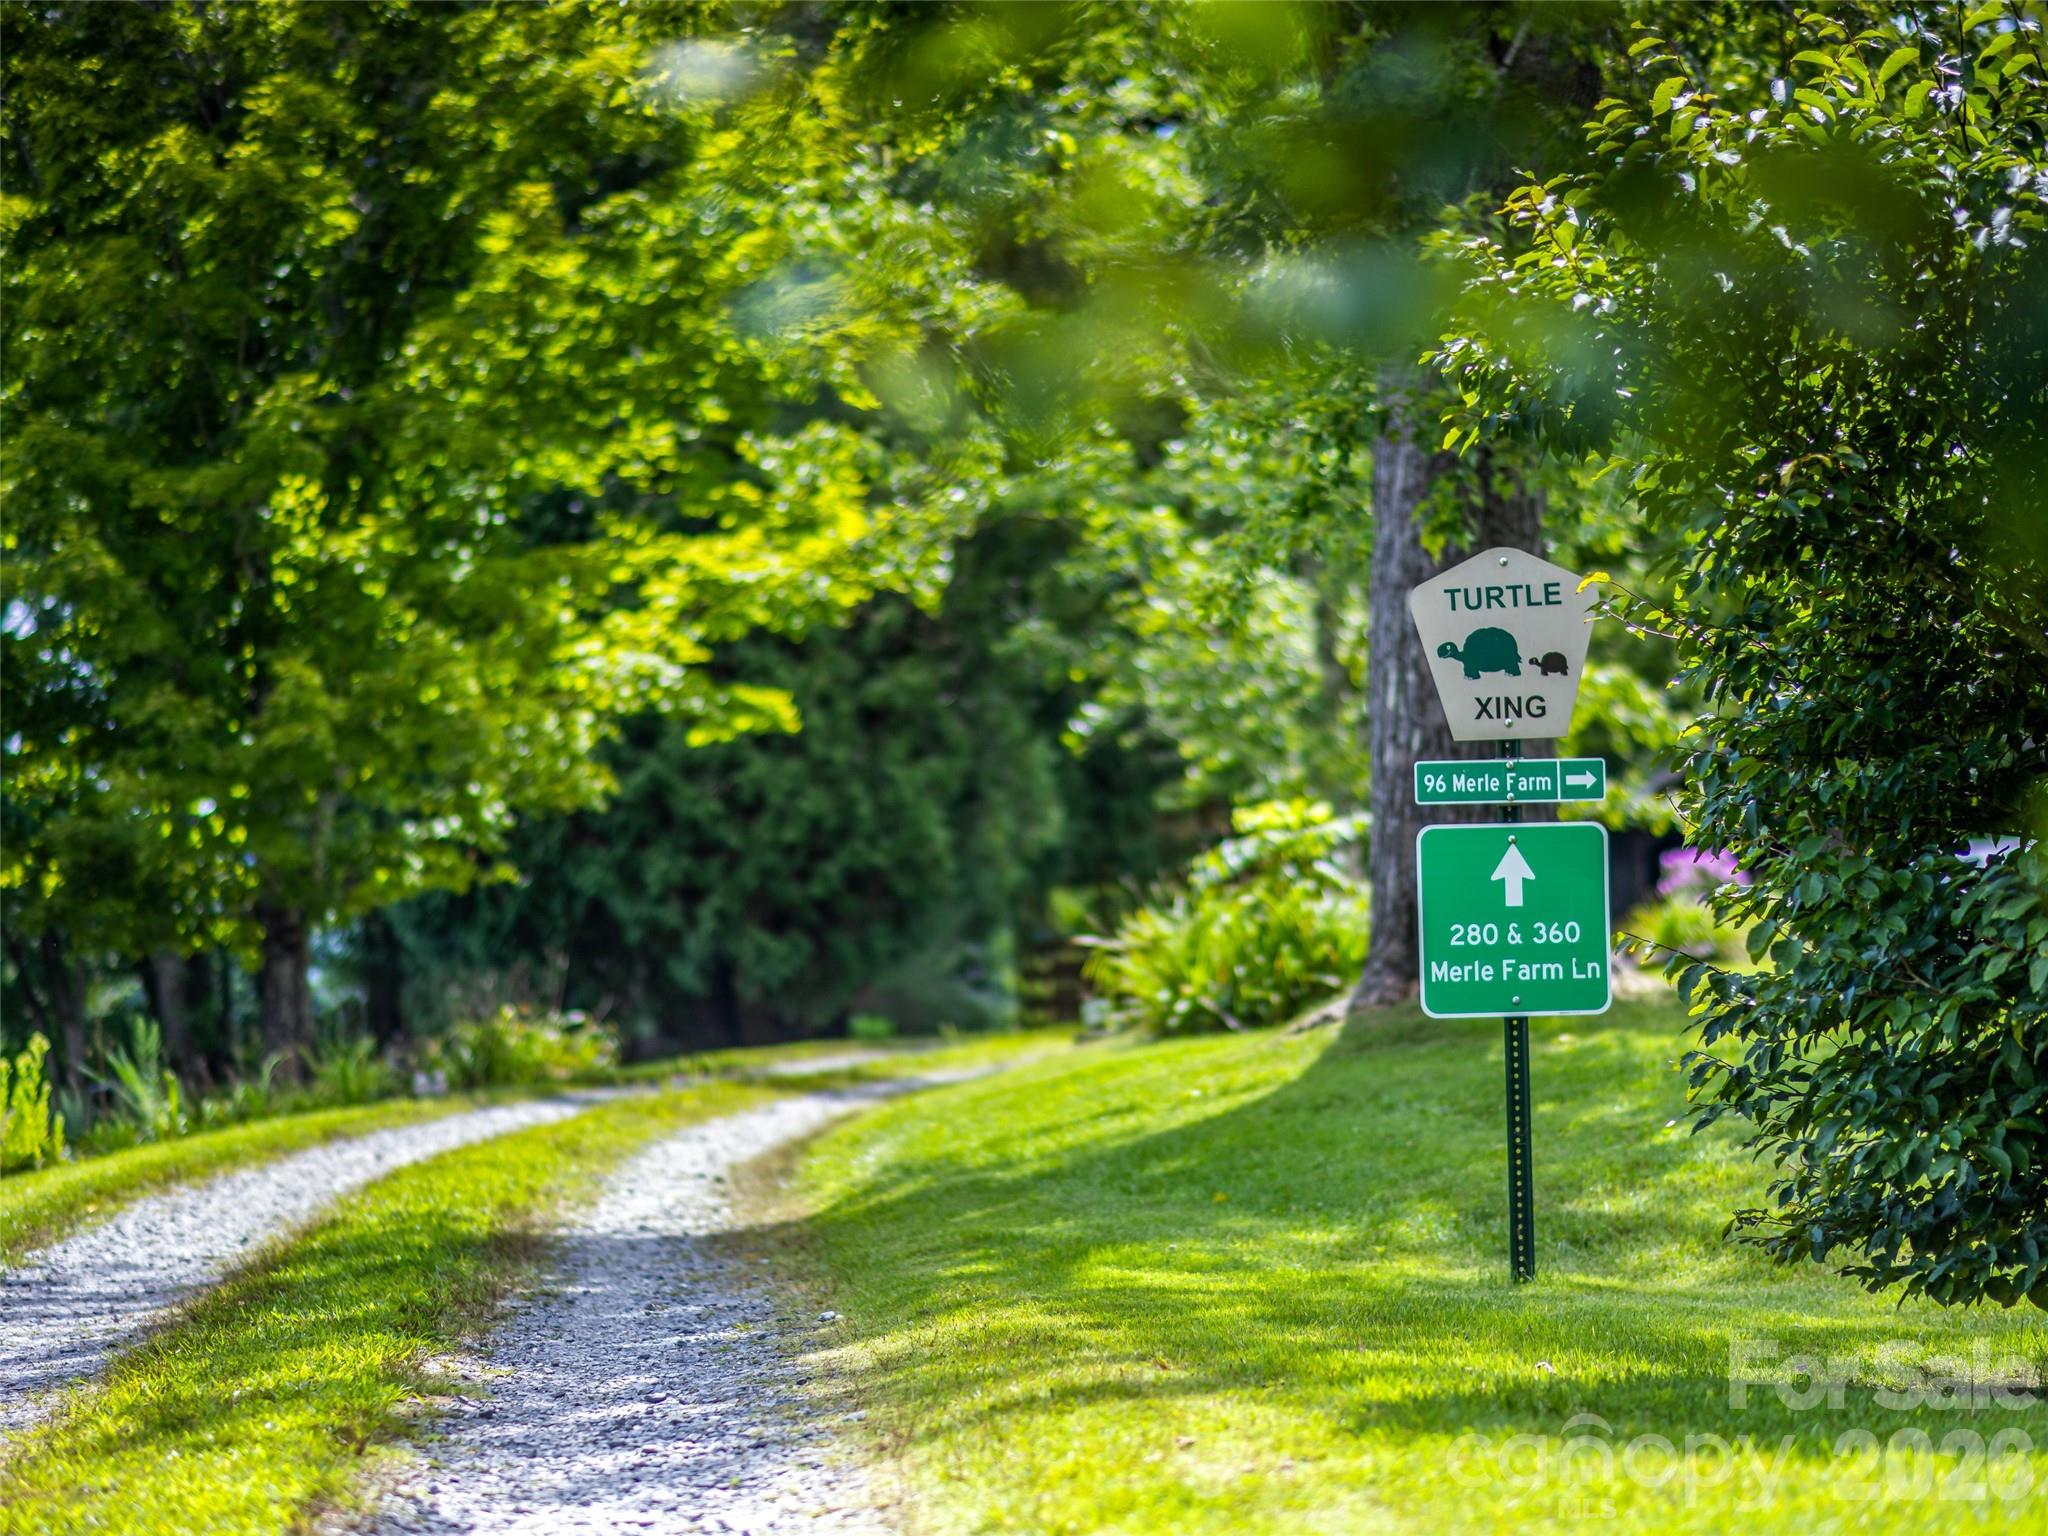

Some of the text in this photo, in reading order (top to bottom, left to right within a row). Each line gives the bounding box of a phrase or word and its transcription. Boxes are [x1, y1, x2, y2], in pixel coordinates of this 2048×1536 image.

[1444, 582, 1562, 611] TURTLE
[1475, 695, 1547, 720] XING
[1424, 772, 1551, 792] 96 Merle Farm
[1450, 921, 1581, 945] 280 & 360
[1431, 957, 1601, 982] Merle Farm Ln
